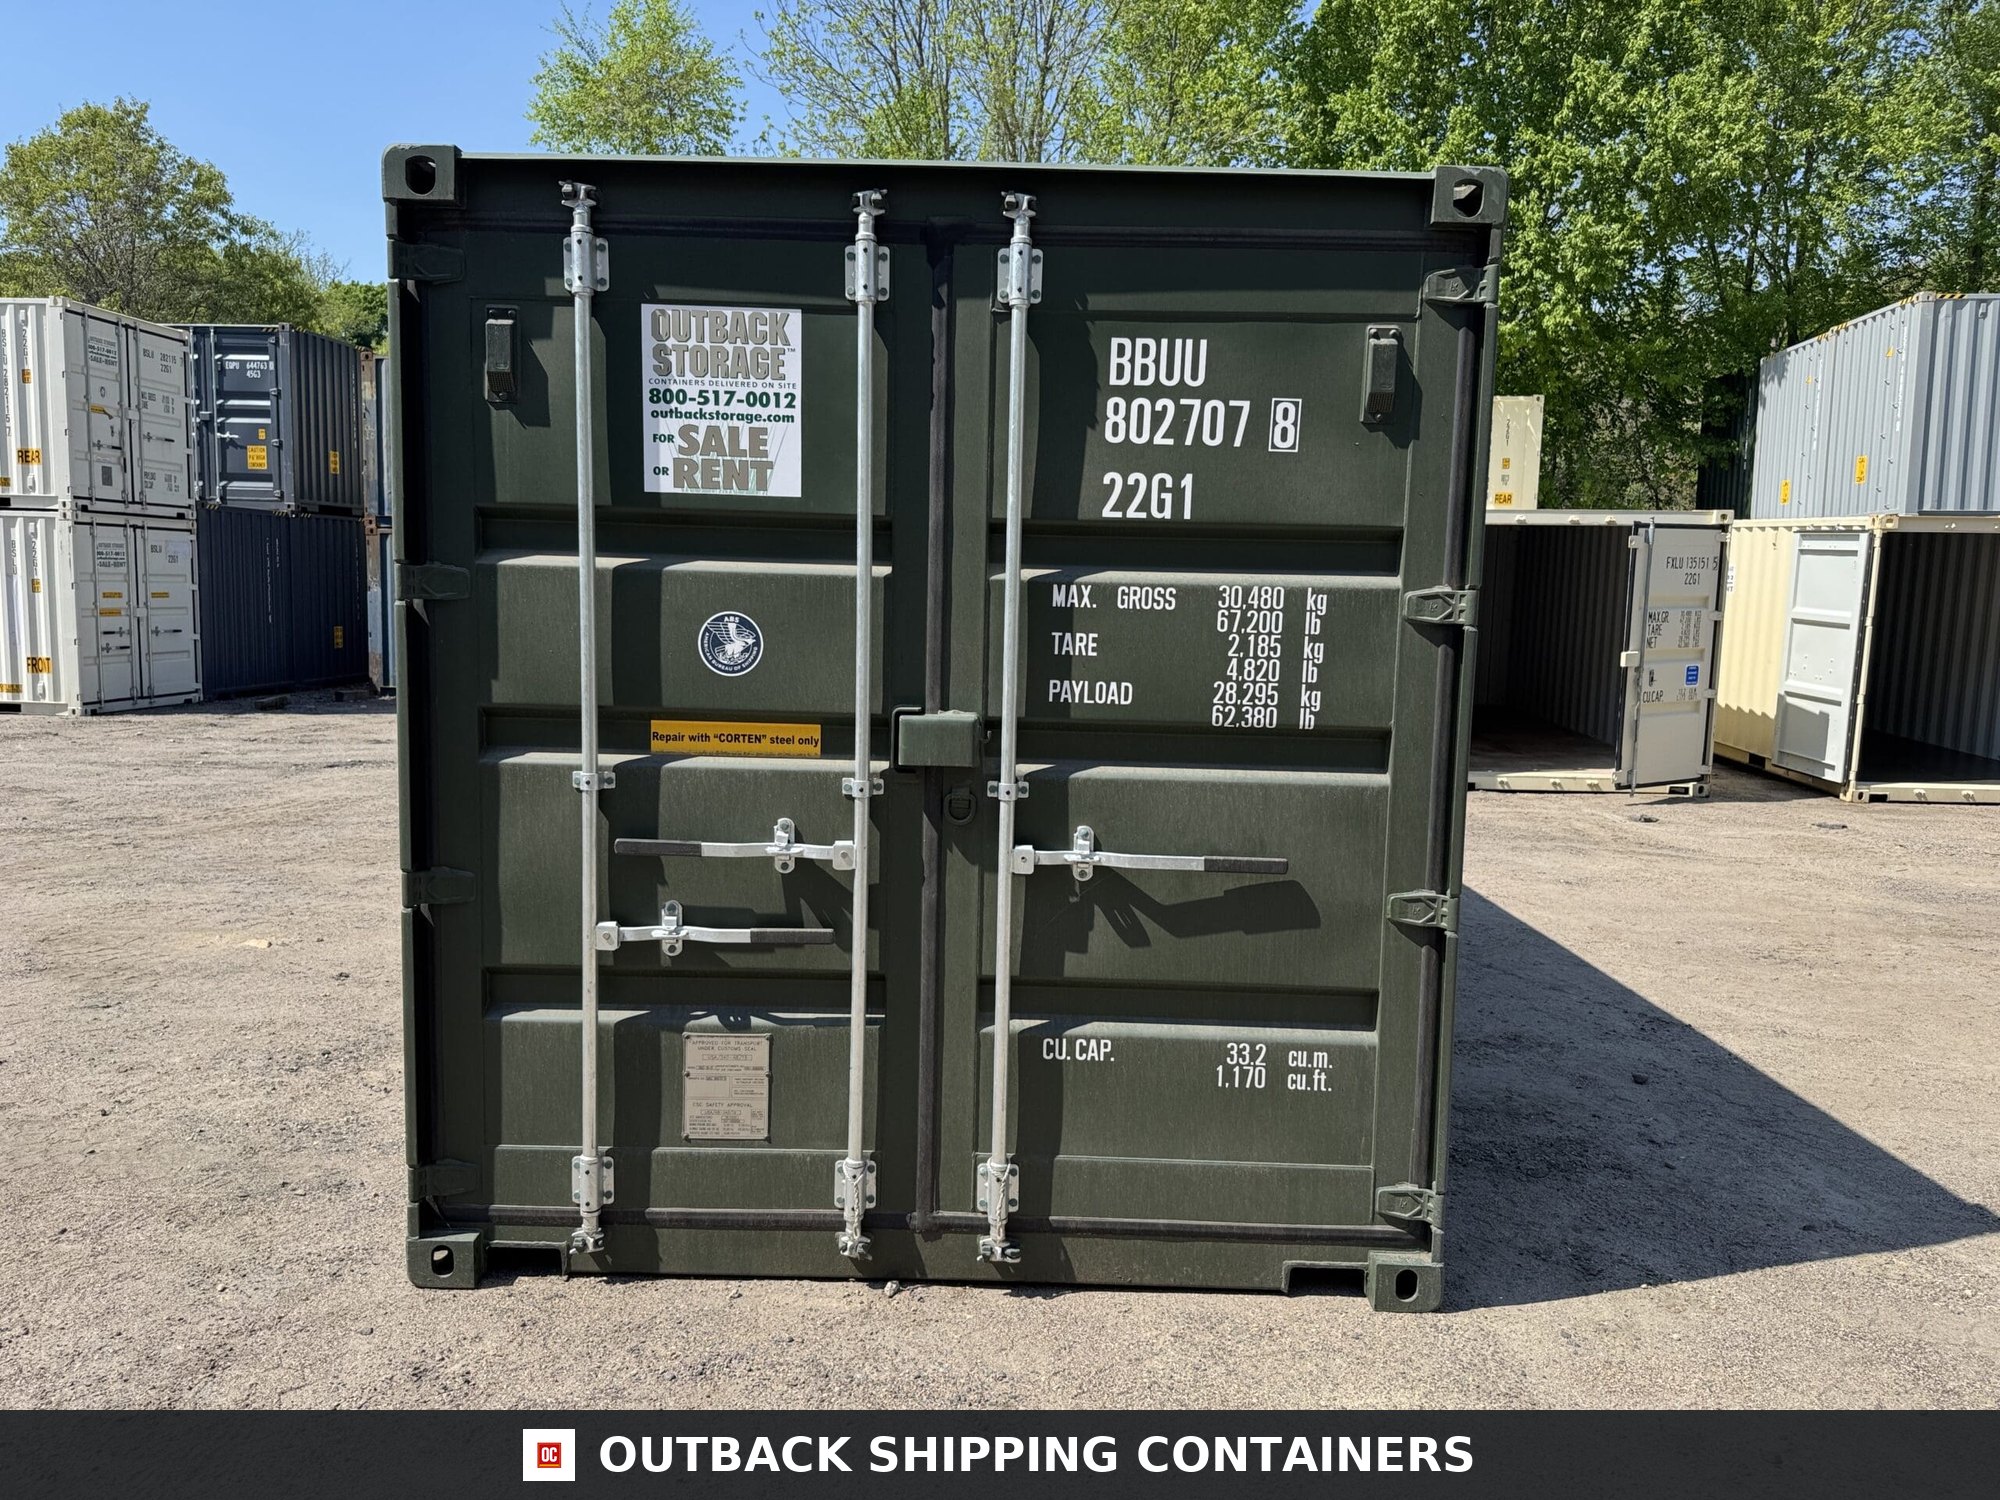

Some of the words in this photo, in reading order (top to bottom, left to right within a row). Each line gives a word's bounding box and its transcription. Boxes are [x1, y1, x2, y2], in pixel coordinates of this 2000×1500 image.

[651, 308, 790, 346] OUTBACK
[246, 361, 268, 370] 644763
[246, 370, 261, 378] 45G3
[652, 343, 786, 381] STORAGE
[1109, 337, 1208, 387] BBUU
[648, 378, 706, 386] CONTAINERS
[708, 380, 758, 388] DELIVERED
[778, 382, 797, 390] SITE
[648, 388, 797, 409] 800-517-0012
[650, 407, 795, 424] outbackstorage.com
[1104, 396, 1250, 448] 802707
[1272, 401, 1297, 449] 8
[652, 433, 675, 444] FOR
[677, 423, 769, 459] SALE
[17, 450, 40, 463] REAR
[653, 466, 669, 476] OR
[672, 457, 774, 491] RENT
[1102, 471, 1193, 520] 22G1
[1666, 556, 1684, 570] FXLU
[1686, 556, 1710, 570] 135151
[1684, 572, 1700, 586] 22G1
[1052, 584, 1097, 609] MAX.
[1117, 586, 1177, 611] GROSS
[1217, 585, 1285, 611] 30,480
[1306, 588, 1328, 616] kg
[1216, 610, 1284, 635] 67,200
[1304, 612, 1321, 635] lb
[1648, 624, 1662, 636] TARE
[1051, 632, 1099, 657] TARE
[1227, 634, 1282, 658] 2,185
[1302, 638, 1324, 664] kg
[1646, 636, 1658, 649] NET
[26, 657, 50, 674] FRONT
[1226, 658, 1280, 682] 4,820
[1302, 659, 1318, 684] lb
[1049, 680, 1134, 706] PAYLOAD
[1212, 682, 1279, 706] 28,295
[1300, 686, 1322, 712] kg
[1211, 705, 1278, 730] 62,380
[1298, 706, 1315, 730] lb
[652, 731, 686, 743] Repair
[688, 732, 711, 743] with
[769, 734, 796, 745] steel
[797, 736, 820, 747] only
[1226, 1042, 1267, 1066] 33.2
[1288, 1050, 1333, 1069] cu.m.
[1216, 1065, 1266, 1088] 1,170
[1287, 1069, 1332, 1092] cu.ft.
